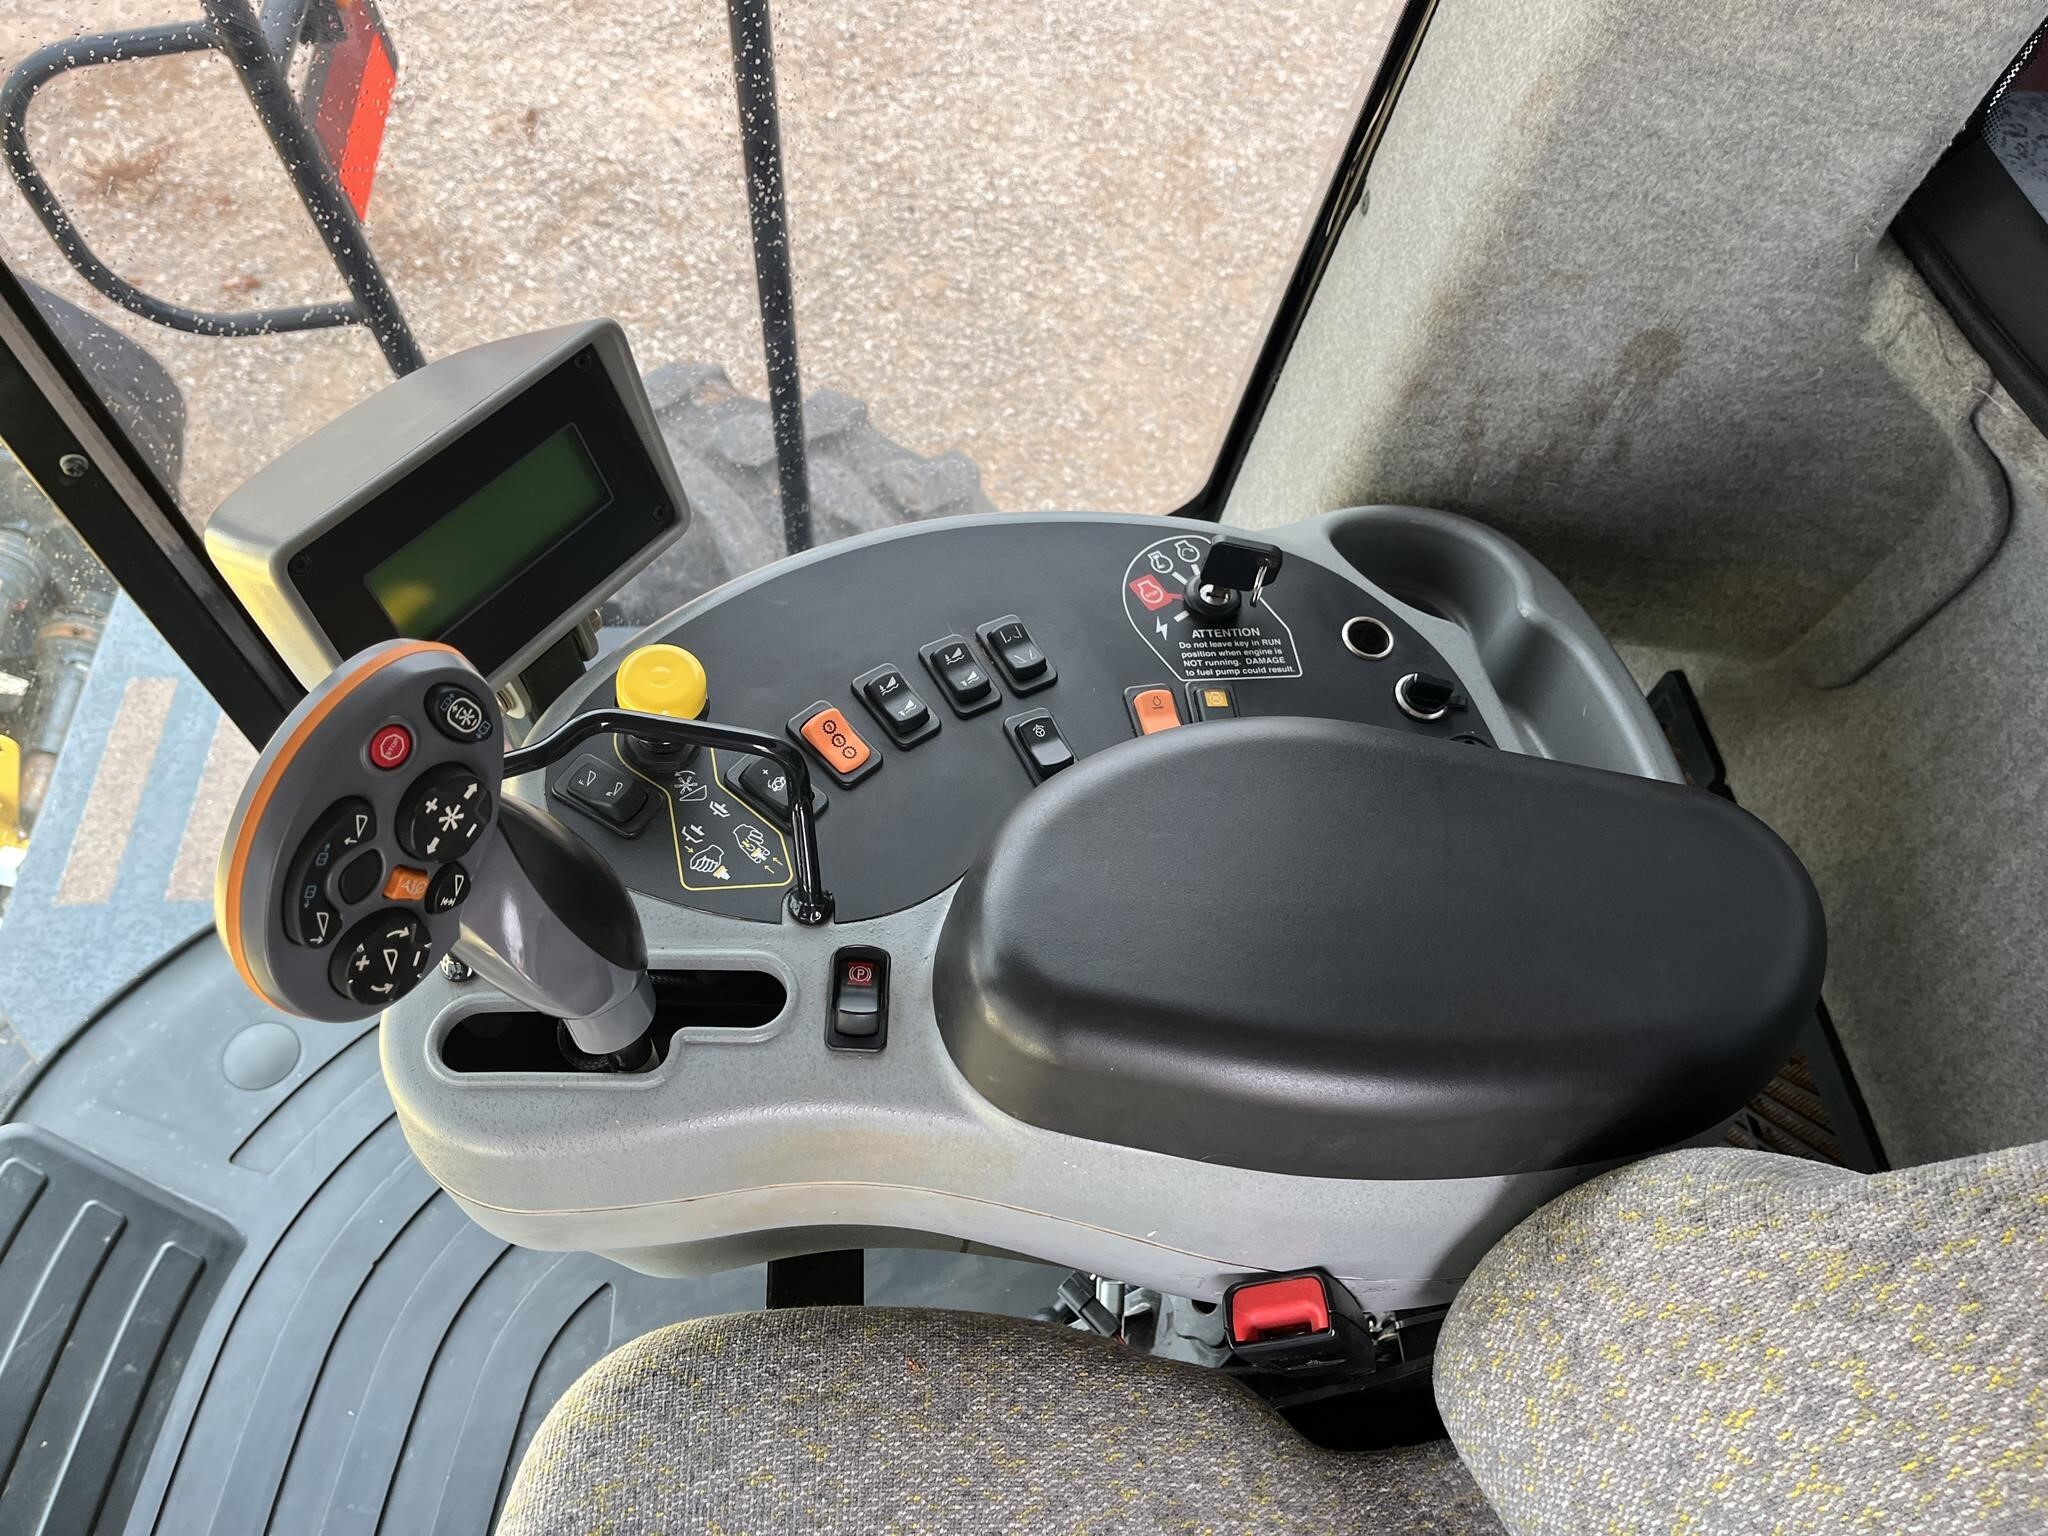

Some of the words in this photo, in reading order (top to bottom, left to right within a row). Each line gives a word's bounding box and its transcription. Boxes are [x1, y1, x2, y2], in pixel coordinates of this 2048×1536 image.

[1192, 627, 1260, 639] ATTENTION
[1178, 641, 1192, 649] Do
[1193, 640, 1208, 648] not
[1209, 640, 1232, 648] leave
[1234, 640, 1249, 648] key
[1251, 639, 1259, 647] in
[1261, 638, 1281, 646] RUN
[1181, 649, 1216, 659] position
[1218, 649, 1242, 657] when
[1243, 648, 1273, 657] engine
[1183, 659, 1203, 667] NOT
[1204, 658, 1241, 668] running.
[1245, 656, 1286, 665] DAMAGE
[1185, 669, 1195, 677] to
[1196, 668, 1213, 676] fuel
[1215, 668, 1240, 677] pump
[1242, 666, 1267, 674] could
[1268, 665, 1296, 673] result.
[857, 968, 865, 979] P
